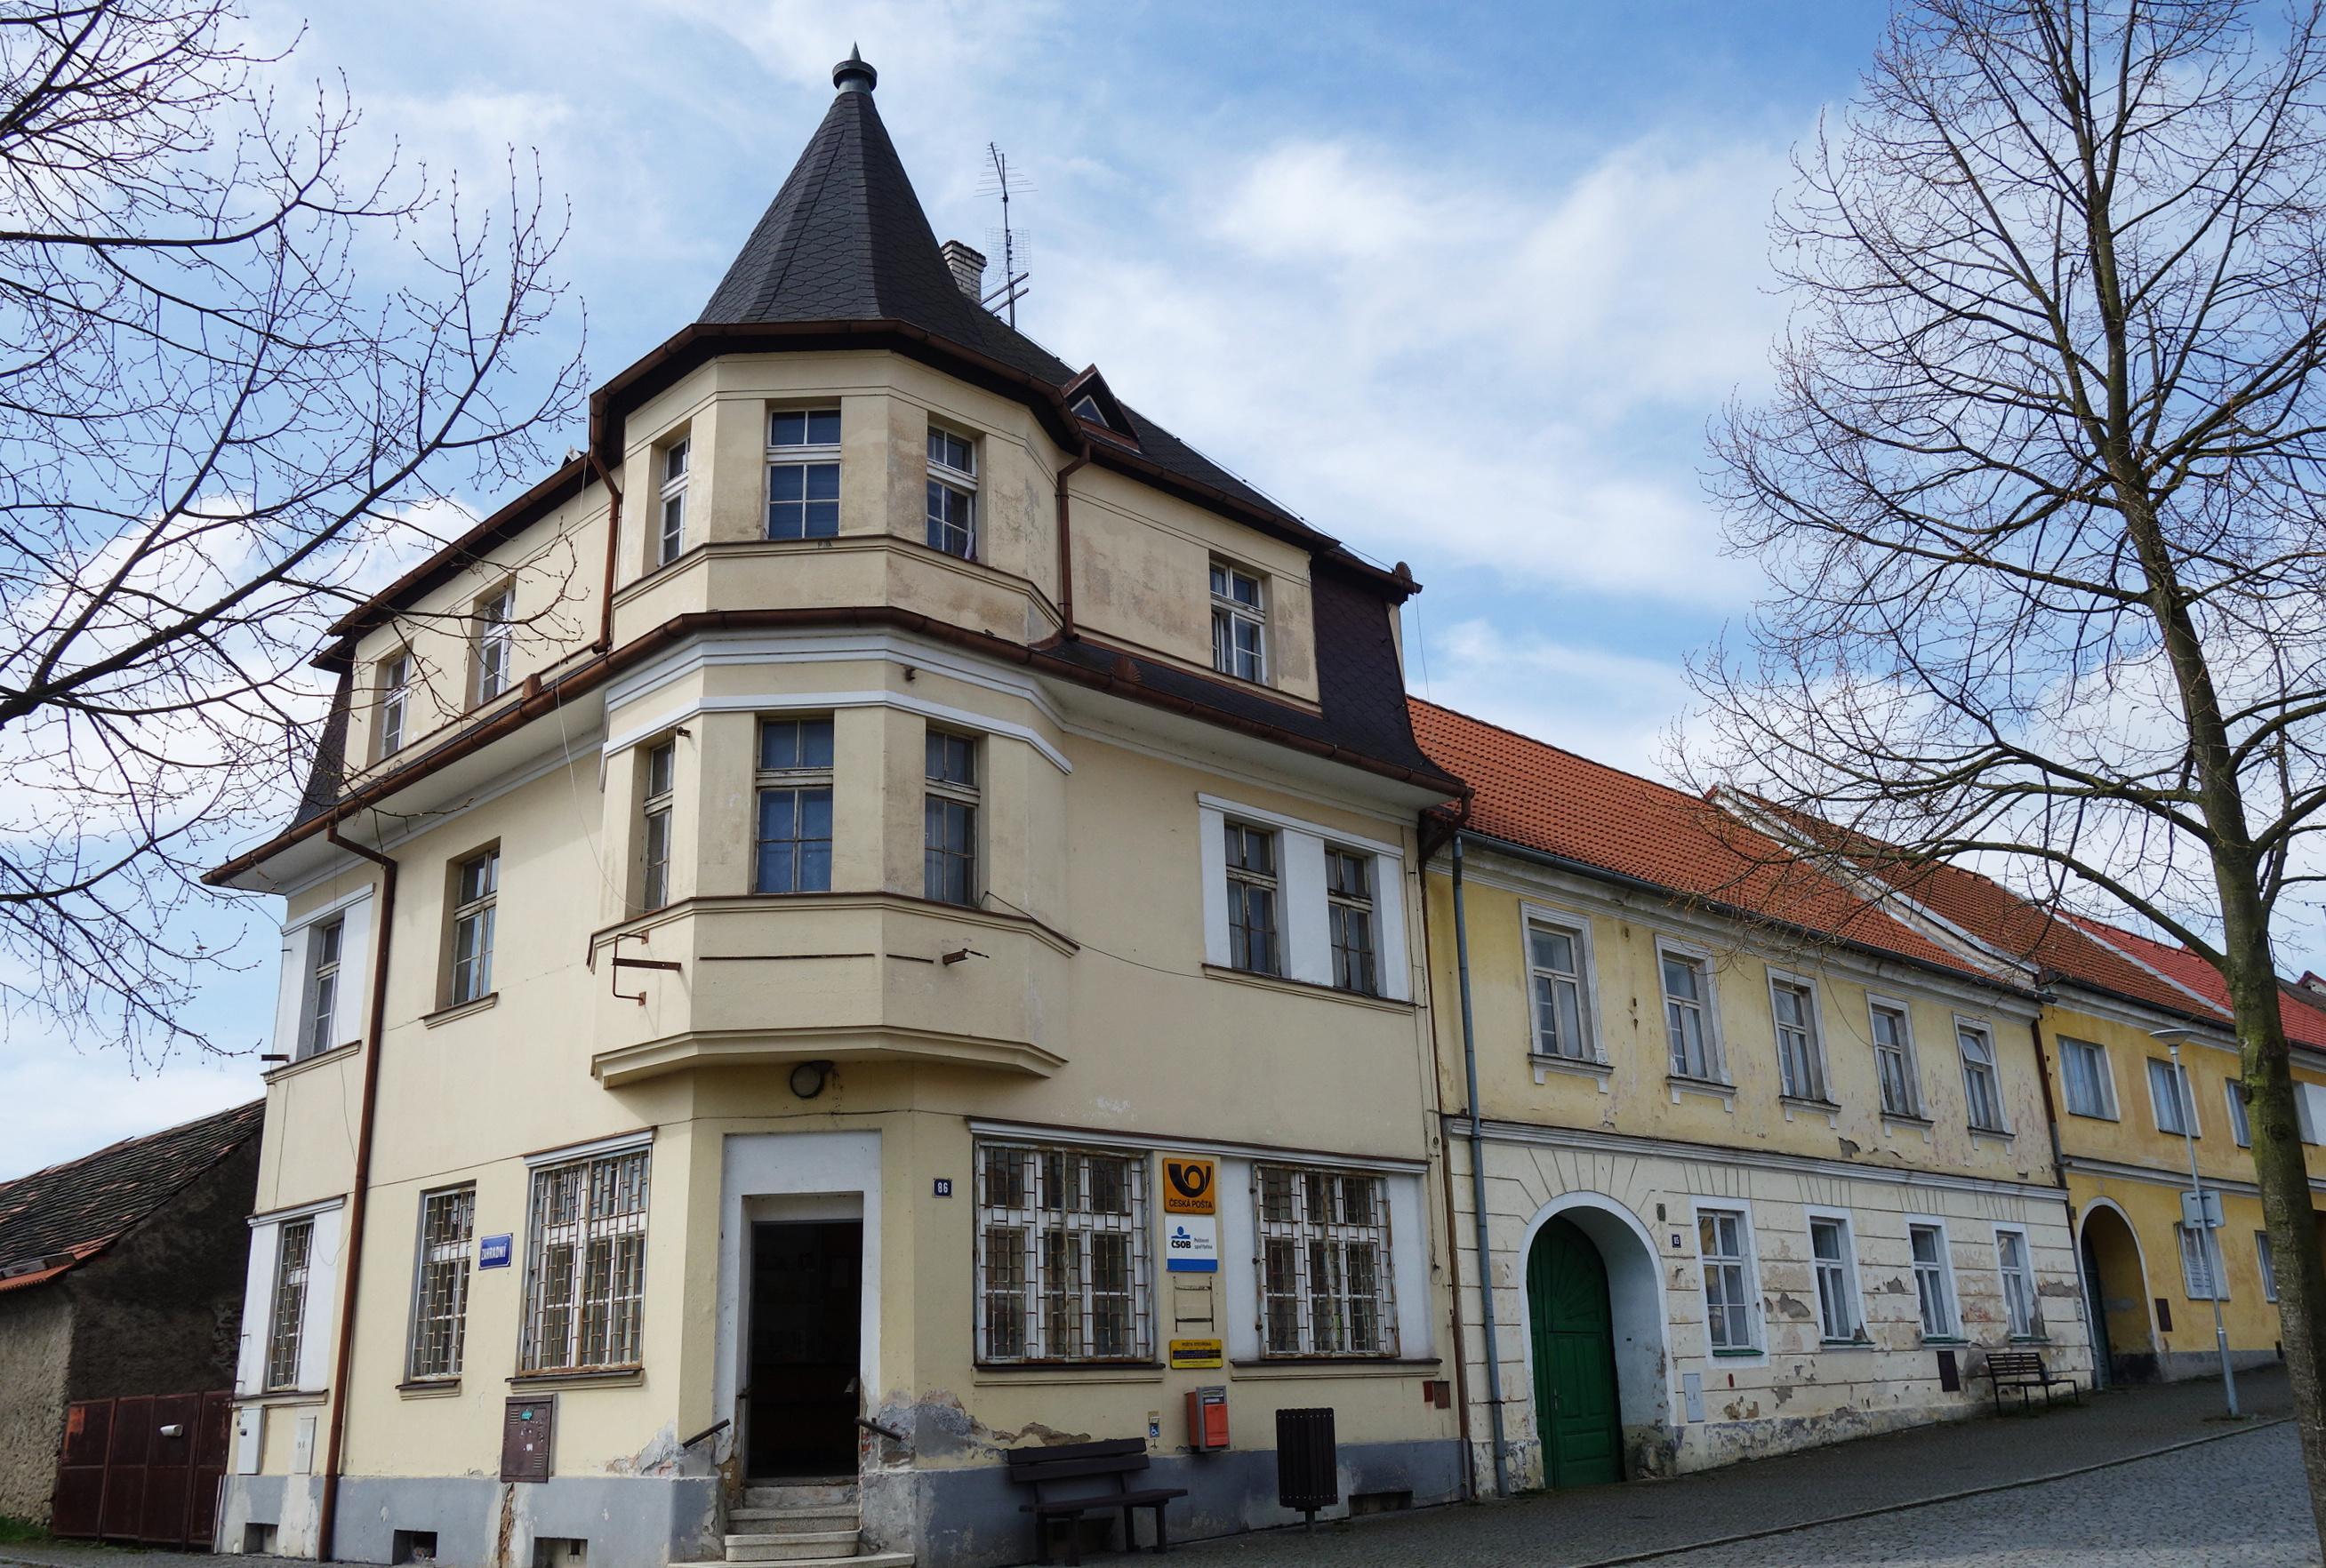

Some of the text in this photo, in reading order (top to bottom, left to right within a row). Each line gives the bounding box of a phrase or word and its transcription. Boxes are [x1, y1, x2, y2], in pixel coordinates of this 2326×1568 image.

[938, 1181, 949, 1194] 86
[1169, 1197, 1213, 1209] ČESKÁ POŠTA
[1171, 1239, 1191, 1249] ČSOB
